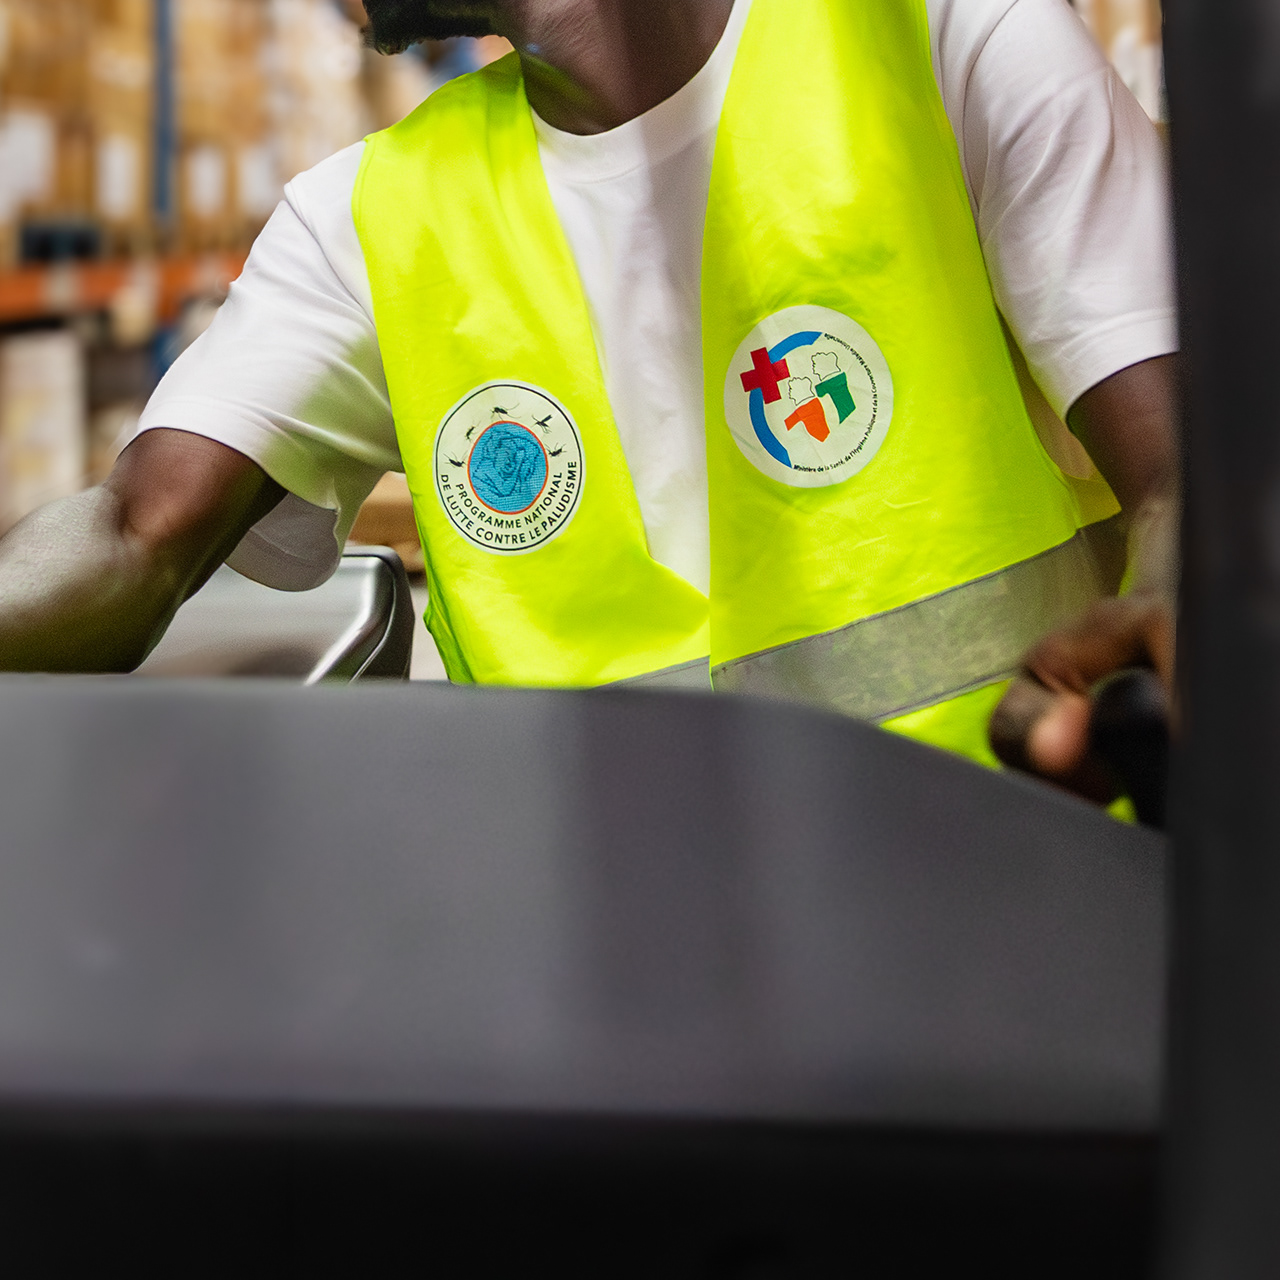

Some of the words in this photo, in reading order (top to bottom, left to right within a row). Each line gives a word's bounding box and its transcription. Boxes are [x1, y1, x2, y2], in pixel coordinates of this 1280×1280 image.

[440, 474, 451, 492] DE
[446, 494, 475, 530] LUTTE
[475, 527, 526, 544] CONTRE
[529, 526, 542, 540] LE
[542, 461, 577, 531] PALUDISME
[455, 483, 522, 529] PROGRAMME
[525, 471, 563, 526] NATIONAL
